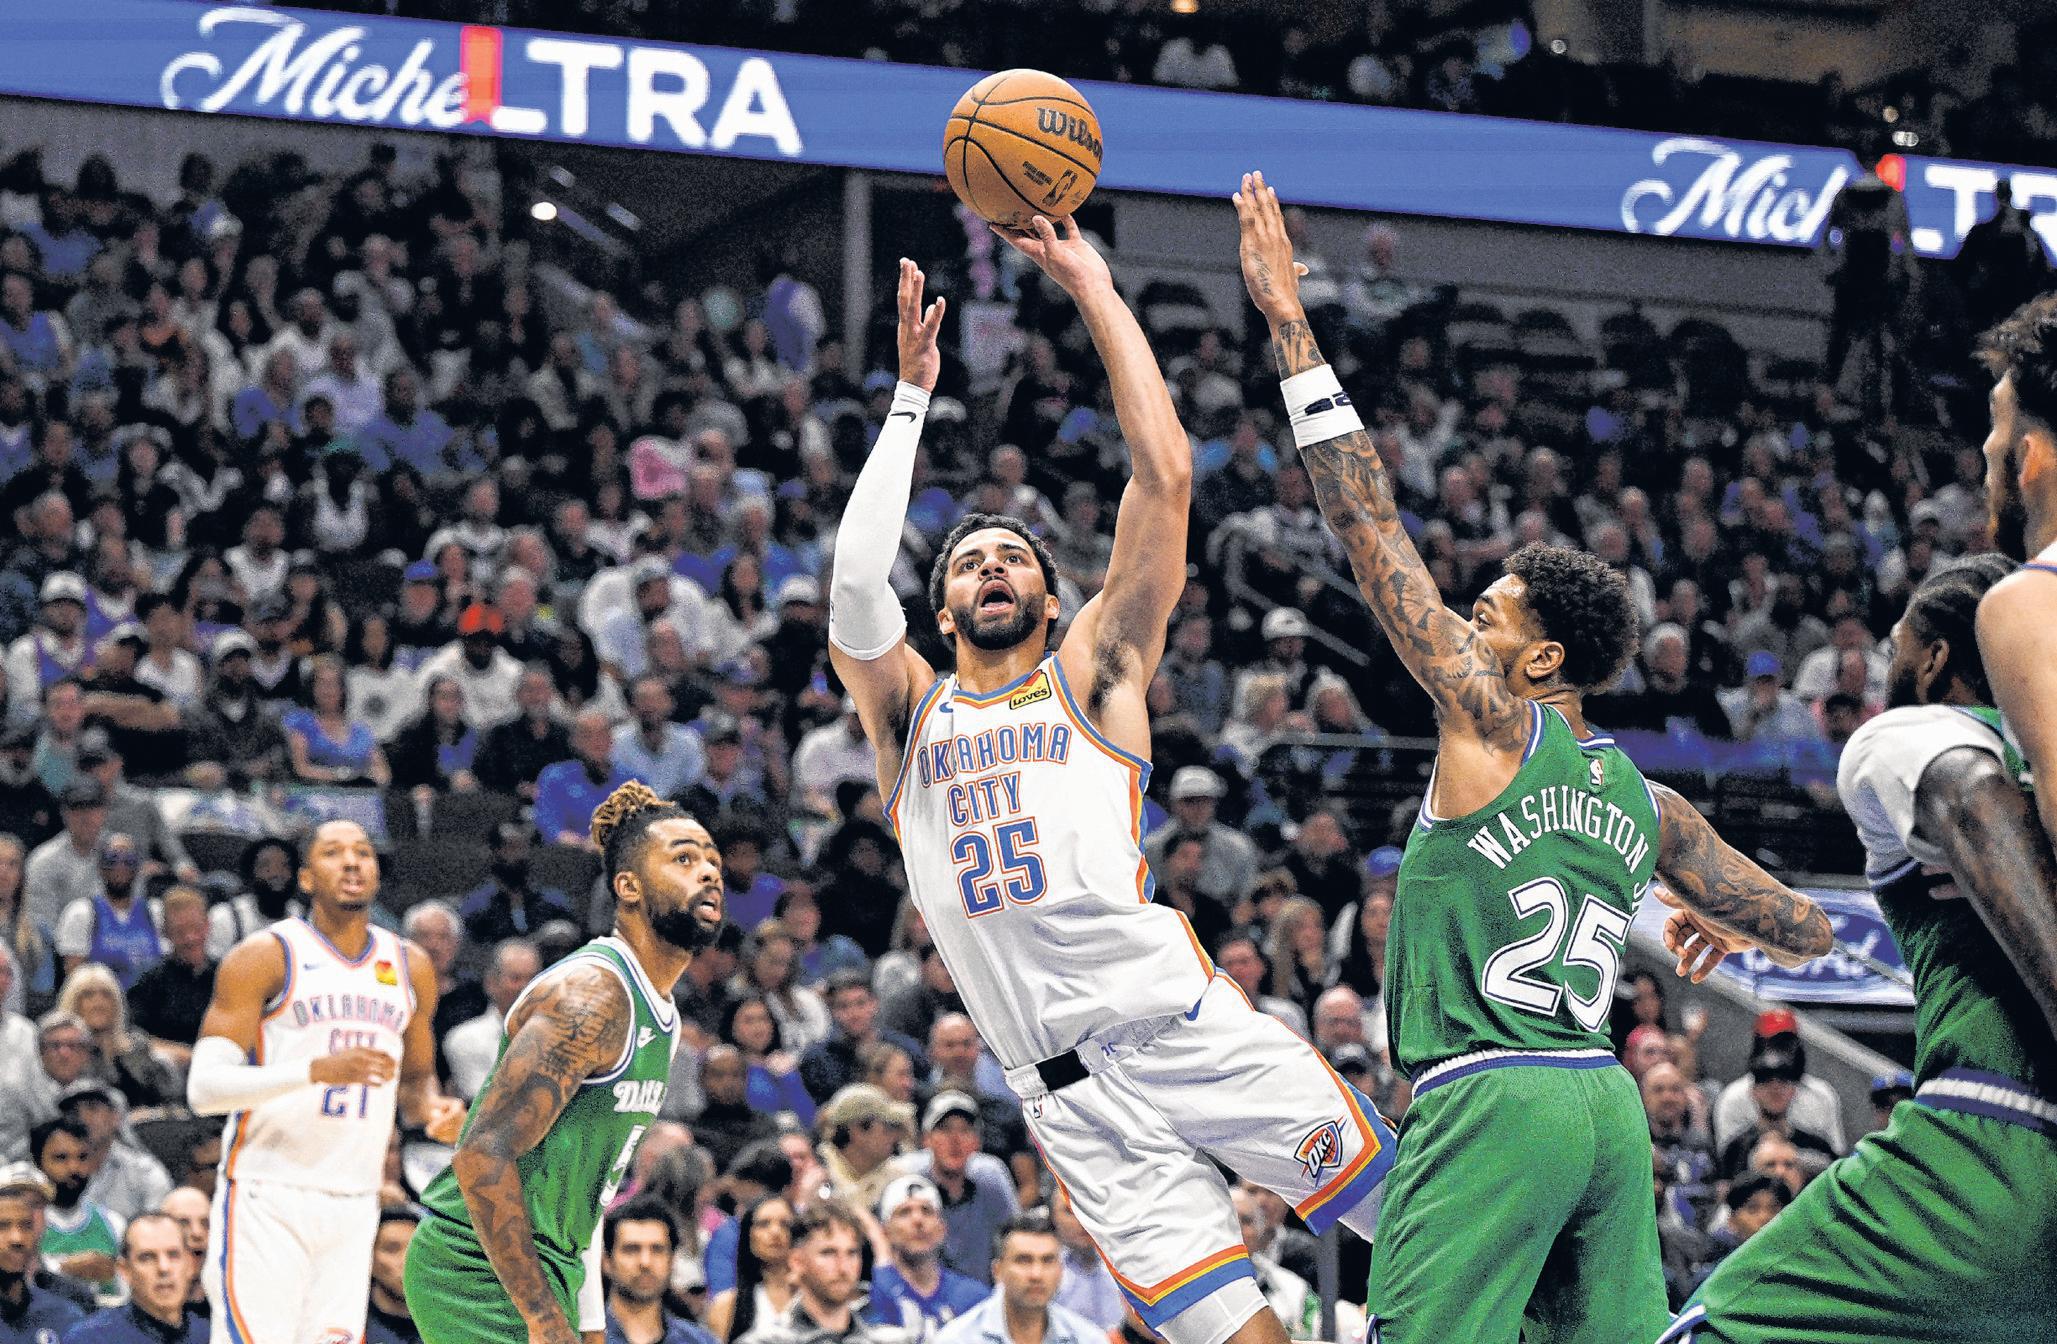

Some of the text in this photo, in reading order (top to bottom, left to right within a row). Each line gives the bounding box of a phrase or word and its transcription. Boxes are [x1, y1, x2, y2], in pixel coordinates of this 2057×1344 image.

[917, 722, 1072, 788] OKAHOMA
[946, 770, 1021, 828] CITY
[1467, 785, 1650, 874] WASHINGTON
[950, 816, 1048, 919] 25
[1481, 876, 1631, 1033] 25
[1306, 1128, 1332, 1178] OKC
